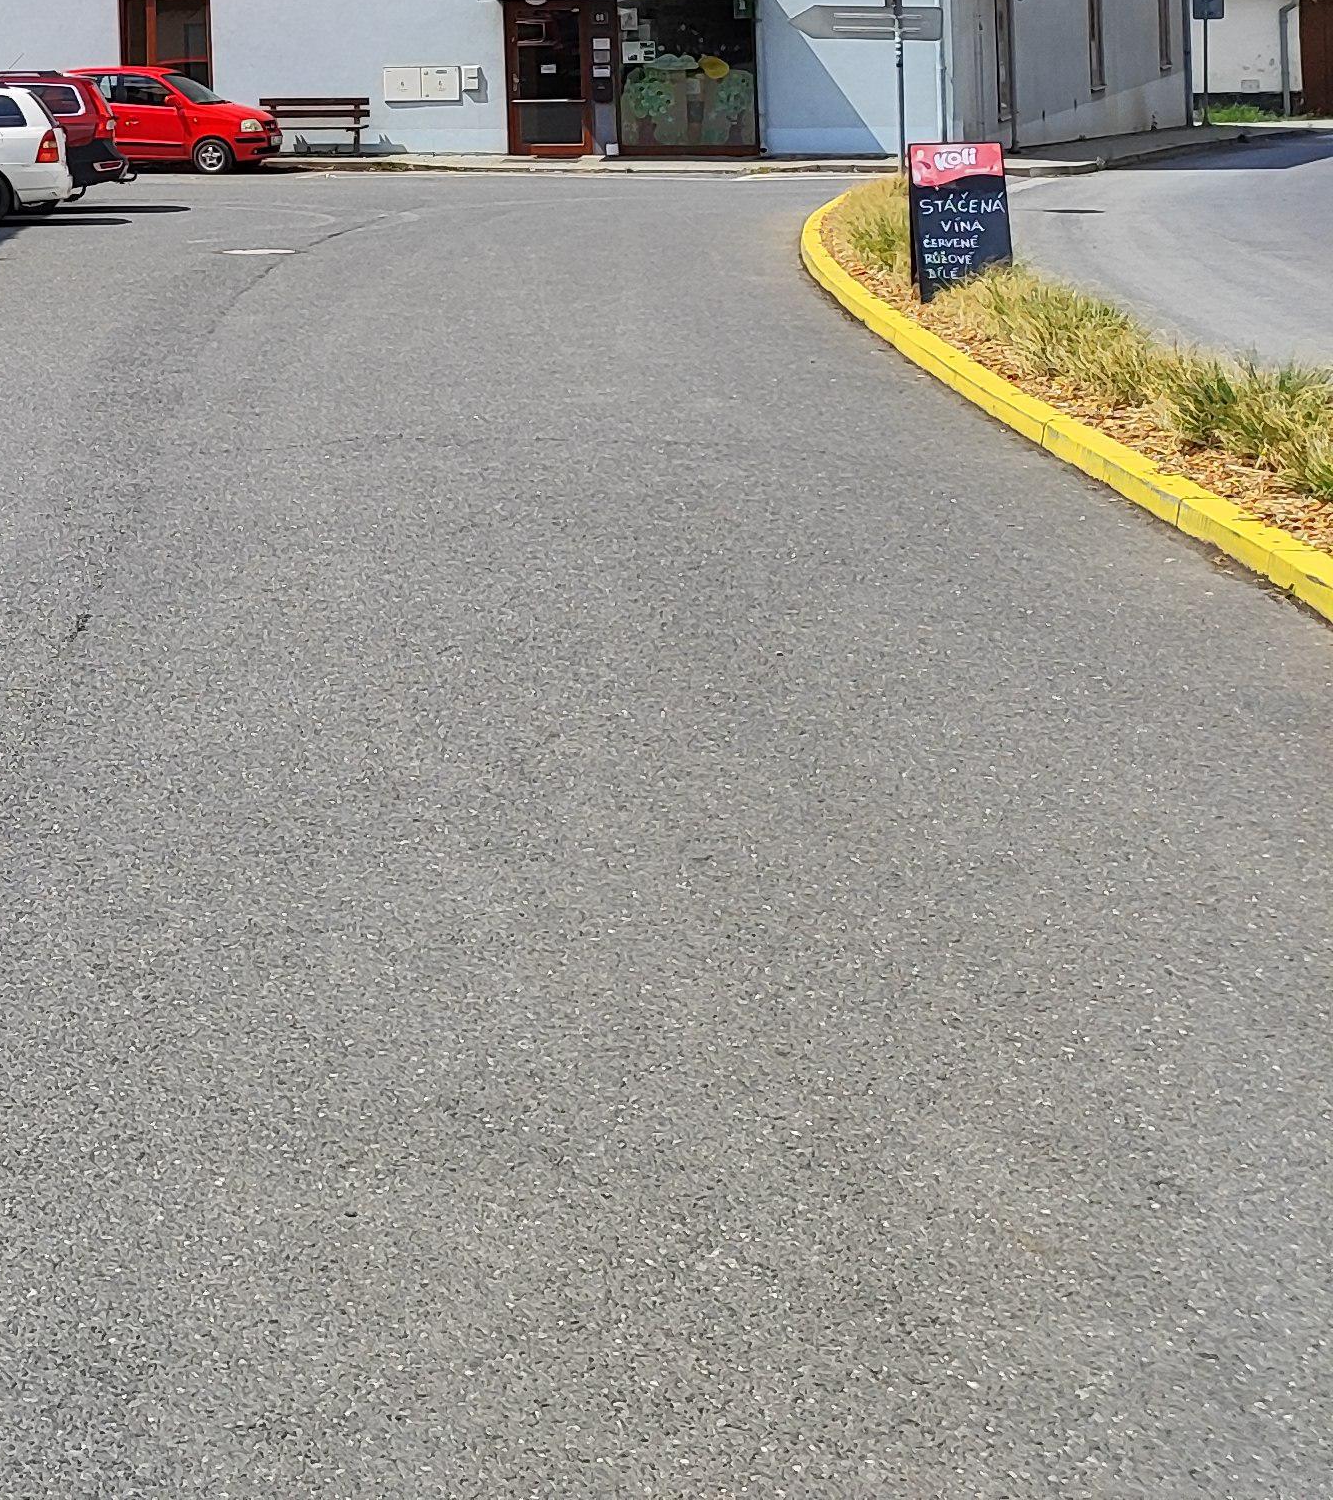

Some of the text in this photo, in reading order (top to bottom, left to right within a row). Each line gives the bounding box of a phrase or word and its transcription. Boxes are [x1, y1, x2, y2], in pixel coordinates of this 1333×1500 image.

[919, 192, 1005, 215] STÁČENÁ
[923, 234, 980, 249] ČERVENÉ
[924, 250, 975, 265] RŮŽOVÉ
